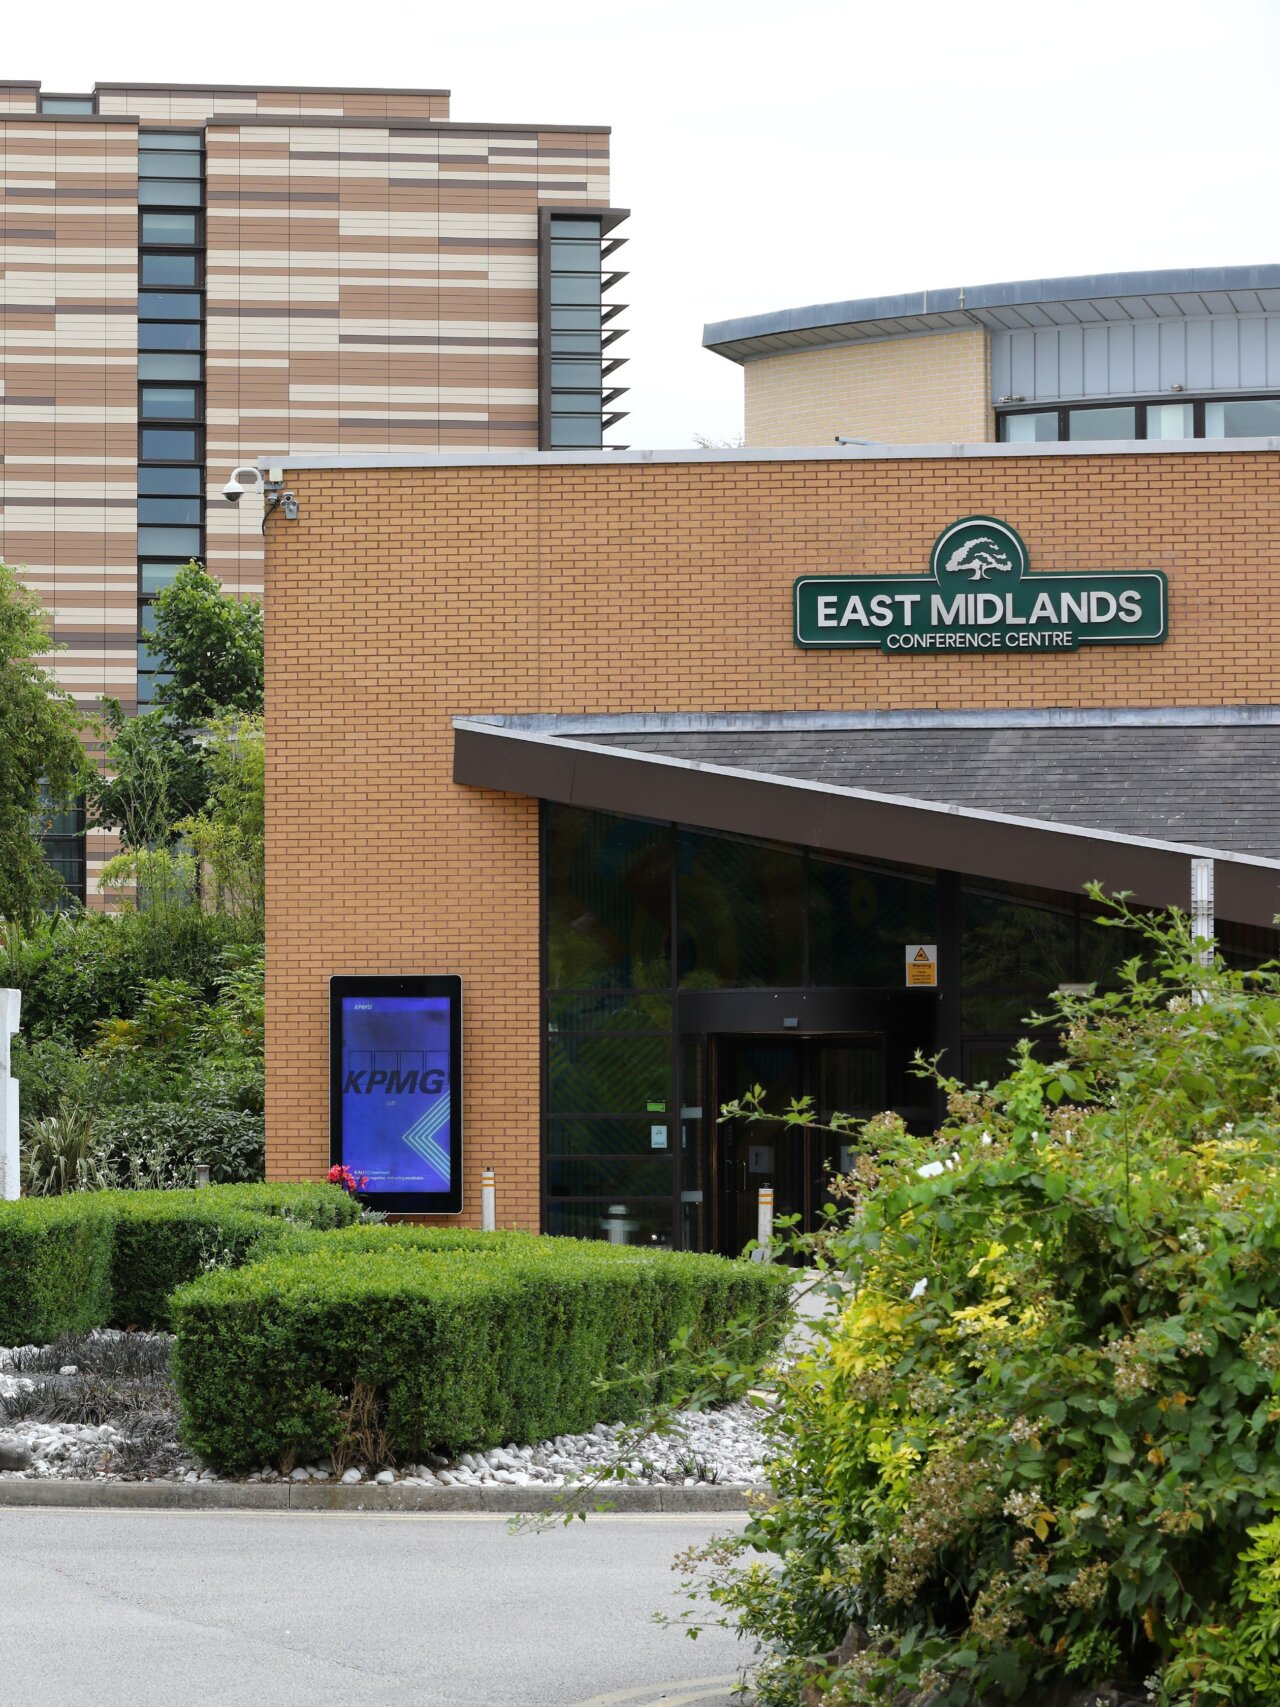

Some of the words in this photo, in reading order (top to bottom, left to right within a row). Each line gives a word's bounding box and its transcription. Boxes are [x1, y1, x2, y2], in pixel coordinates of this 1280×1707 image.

[816, 594, 920, 628] EAST
[930, 590, 1143, 627] MIDLANDS
[886, 632, 1002, 649] CONFERENCE
[1004, 631, 1073, 647] CENTRE
[343, 1069, 446, 1095] KPMG
